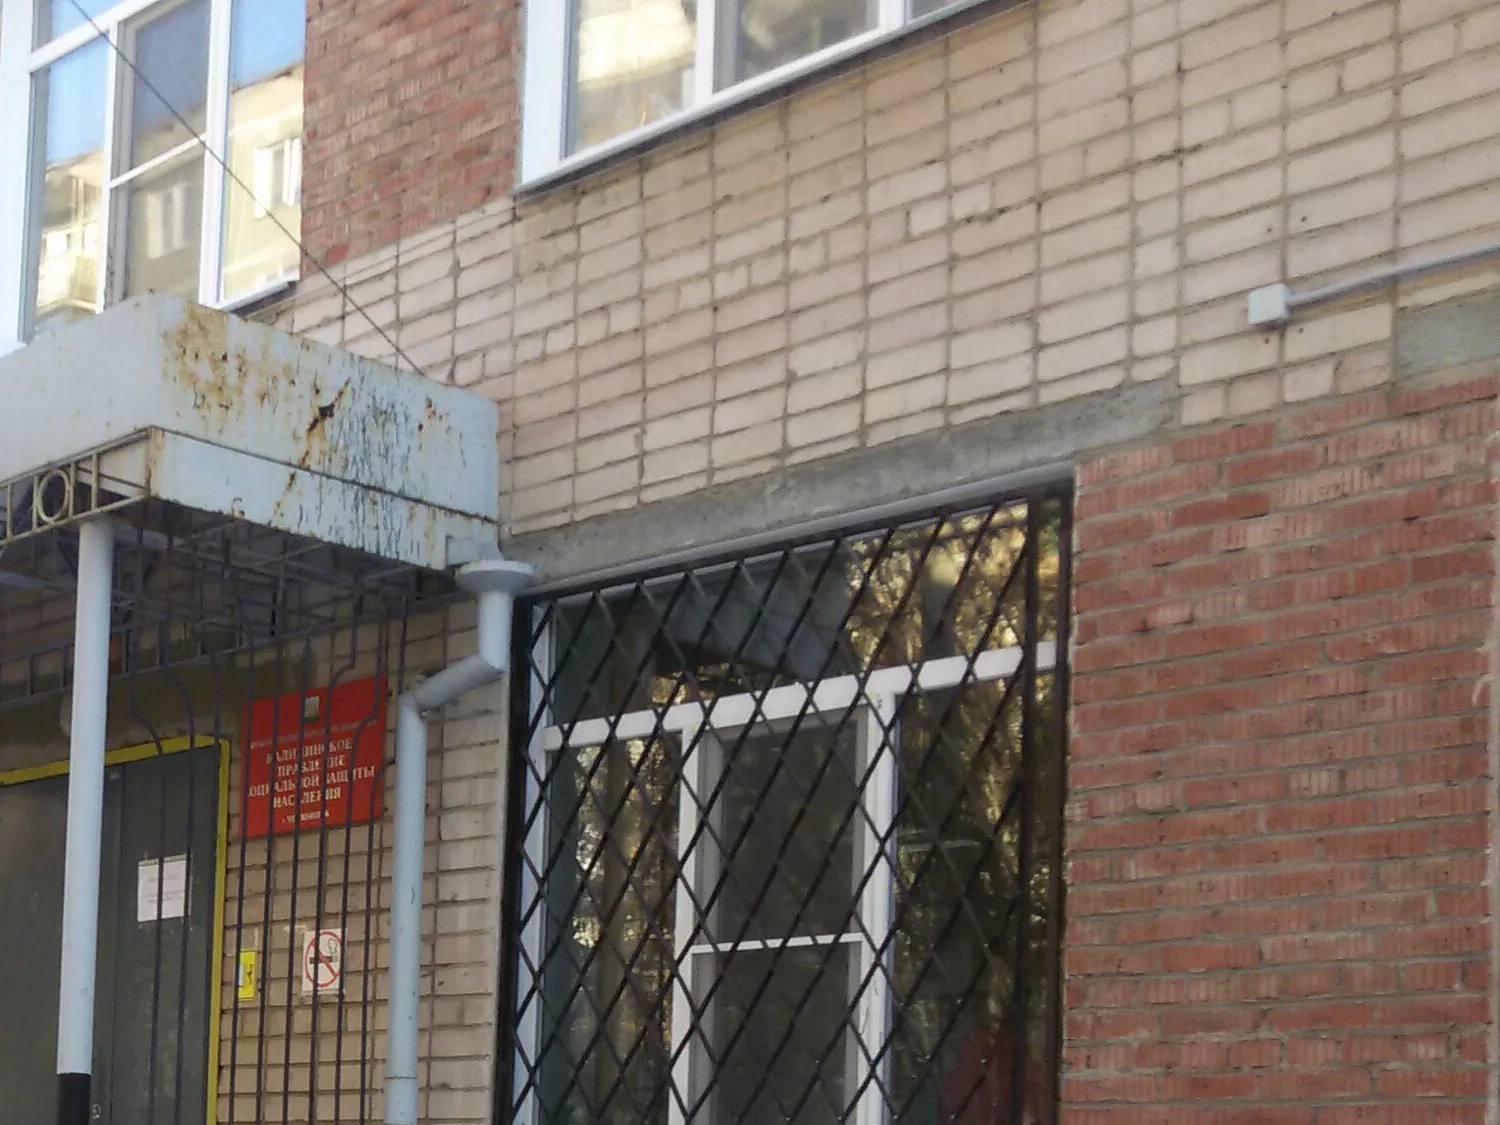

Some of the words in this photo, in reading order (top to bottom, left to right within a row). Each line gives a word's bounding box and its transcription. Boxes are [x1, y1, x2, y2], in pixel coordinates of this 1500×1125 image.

[271, 754, 346, 777] ПРАЛЕИЕ
[243, 776, 320, 798] ОЦАЛЬОЙ
[273, 788, 341, 809] НАСЛЕИЯ
